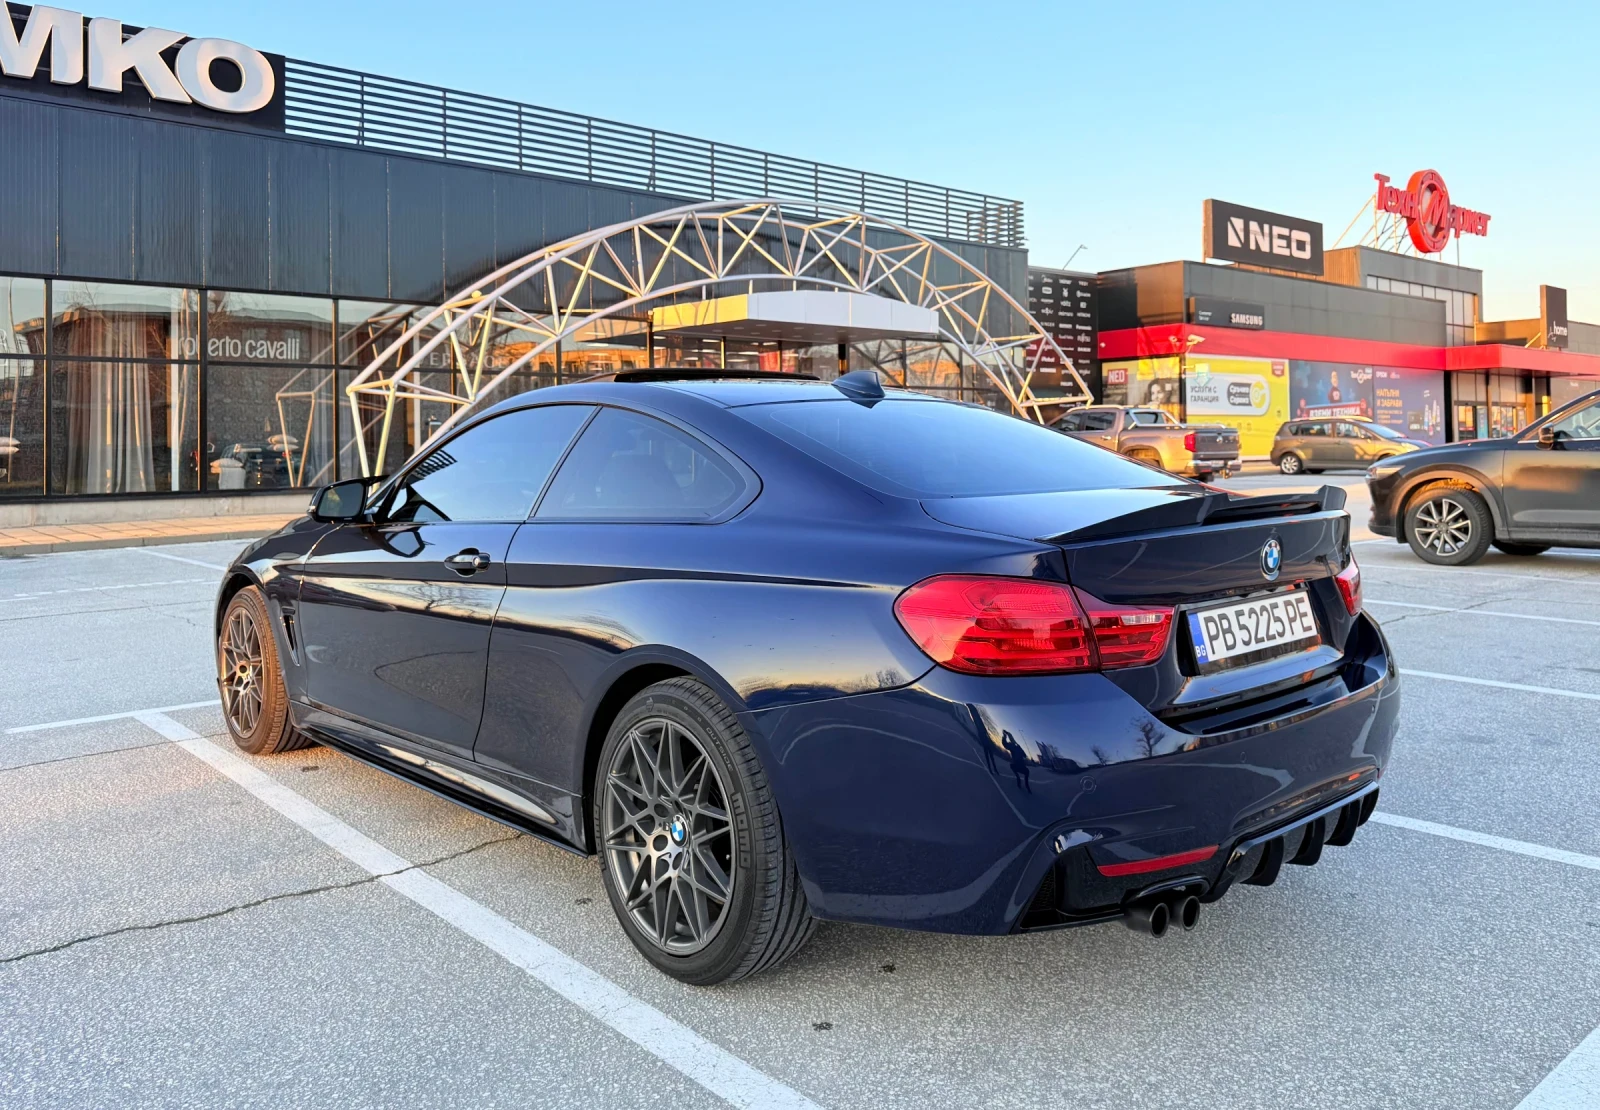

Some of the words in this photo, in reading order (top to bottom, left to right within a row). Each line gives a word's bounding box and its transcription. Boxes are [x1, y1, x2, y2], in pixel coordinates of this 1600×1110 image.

[1249, 220, 1311, 260] NEO
[1231, 312, 1264, 326] SAMSUNG
[245, 338, 300, 360] cavalli
[1108, 369, 1125, 384] NEO
[1190, 385, 1212, 394] УСЛУГИ
[1190, 395, 1220, 403] ГАРАНЦИЯ
[1332, 405, 1361, 417] ТЕХНИКА
[1203, 612, 1237, 655] PB
[1234, 602, 1286, 646] 5225
[1283, 596, 1313, 635] PE
[1195, 645, 1206, 658] BG
[705, 726, 734, 772] OUTSIDE
